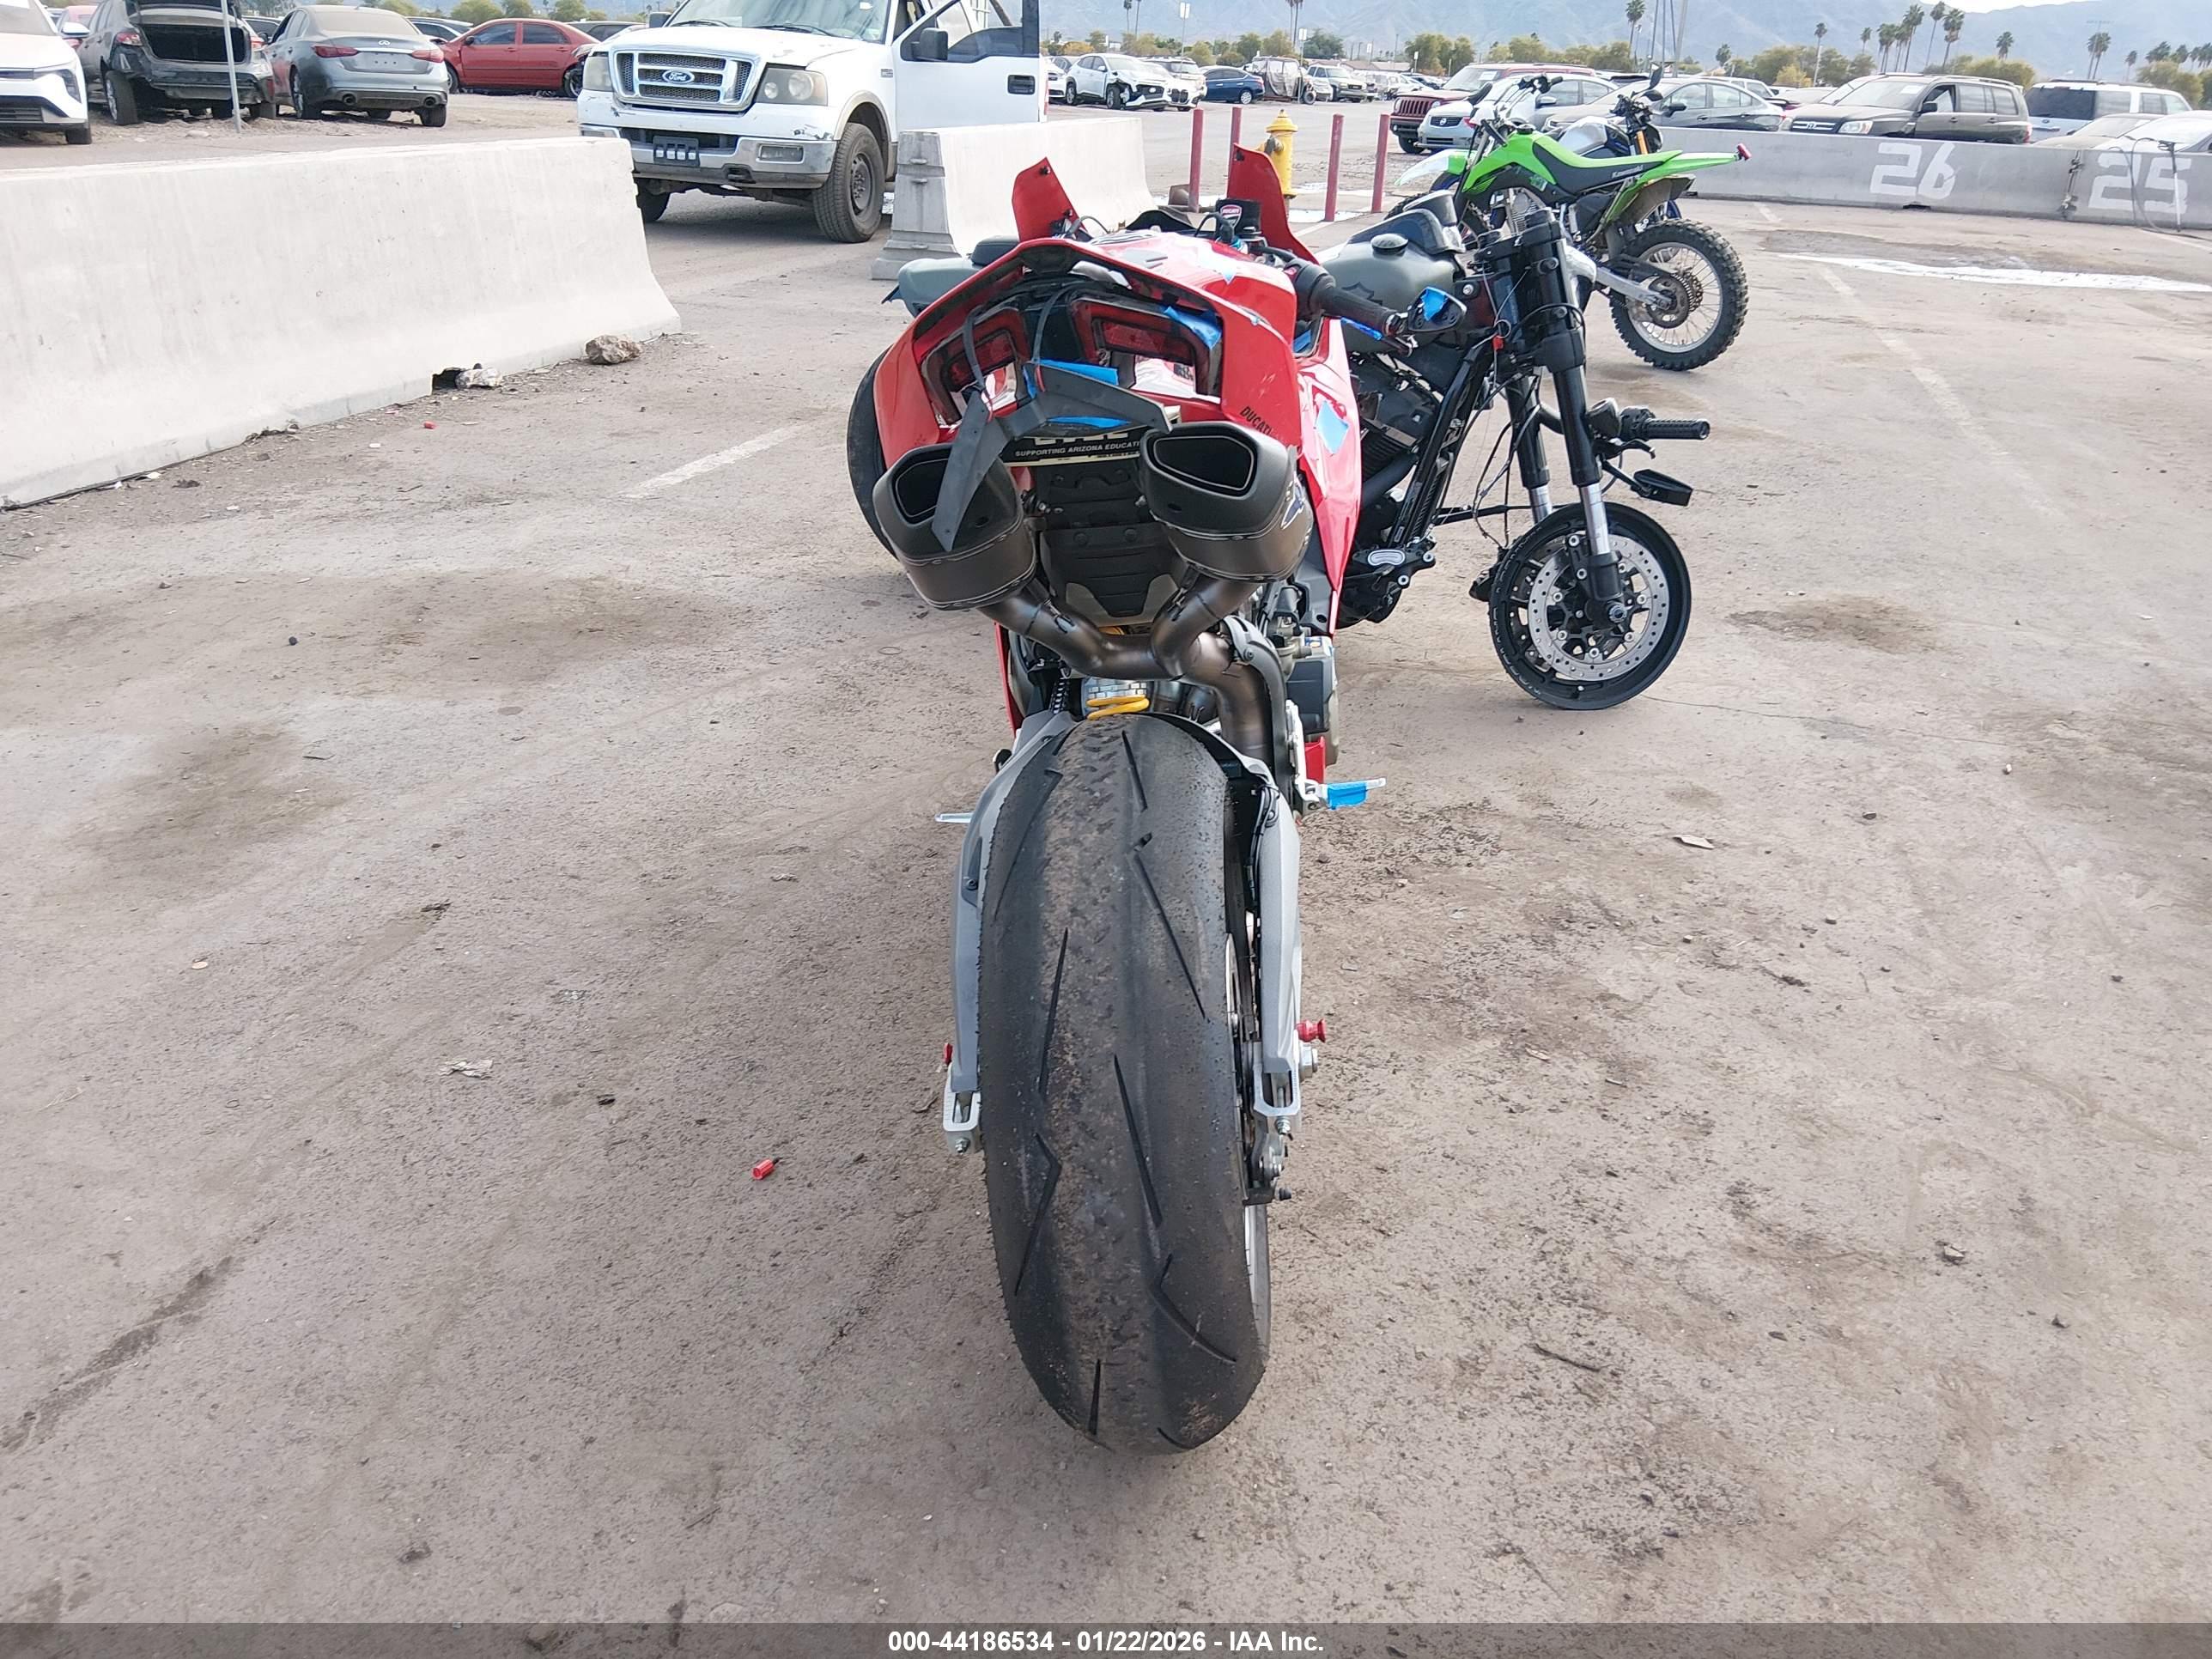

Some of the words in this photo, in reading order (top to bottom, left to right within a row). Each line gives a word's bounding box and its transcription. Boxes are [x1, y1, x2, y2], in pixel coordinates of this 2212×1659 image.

[1869, 142, 1956, 200] 26
[2087, 151, 2193, 215] 25
[1239, 405, 1273, 436] DUCATI
[1015, 447, 1066, 457] SUPPORTING
[1067, 444, 1103, 453] ARIZONA
[1104, 441, 1140, 451] EDUCATI
